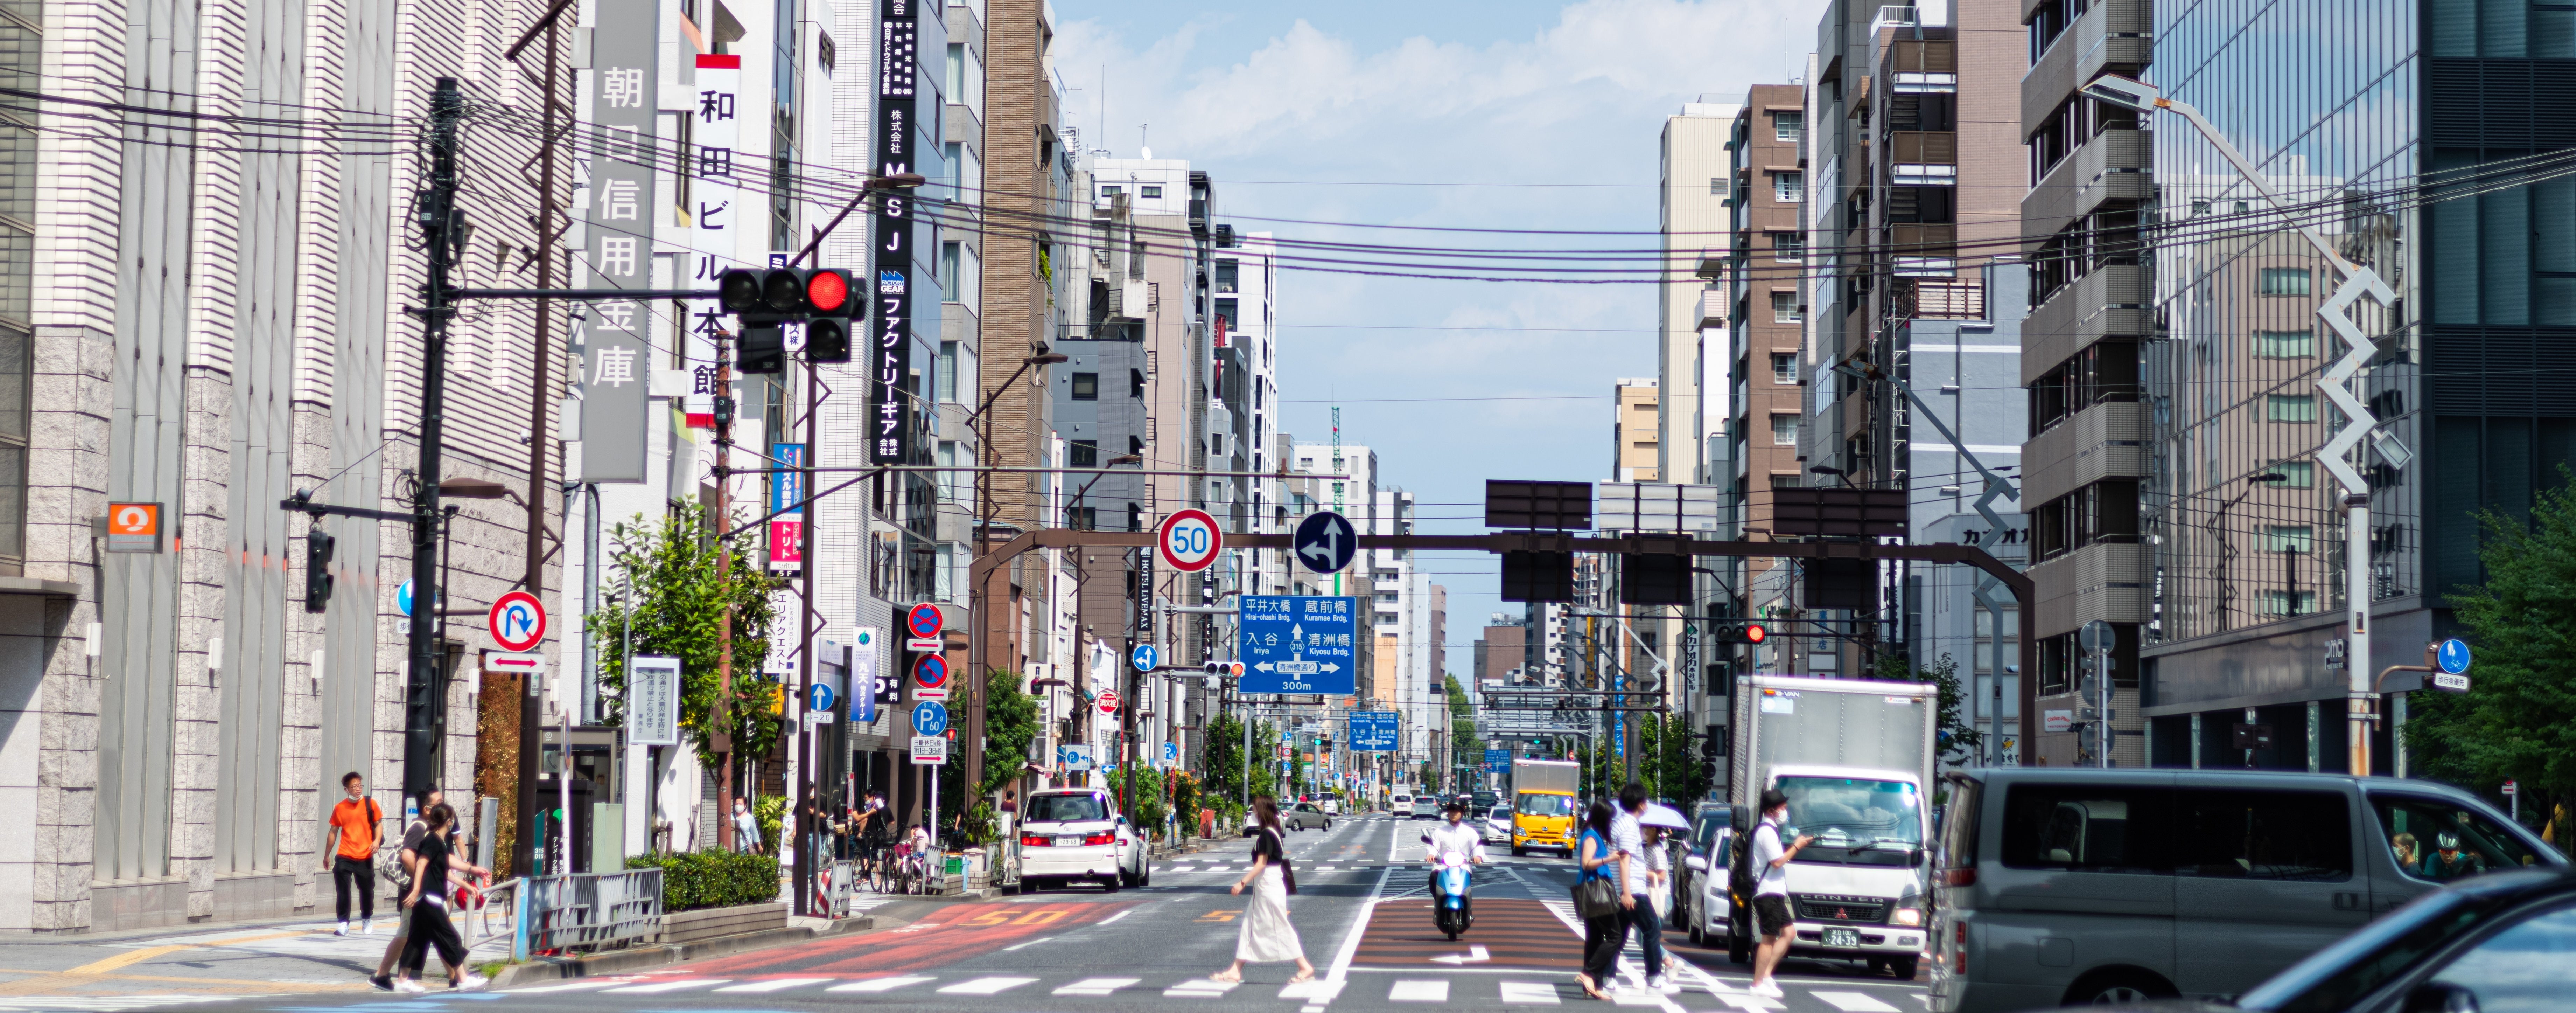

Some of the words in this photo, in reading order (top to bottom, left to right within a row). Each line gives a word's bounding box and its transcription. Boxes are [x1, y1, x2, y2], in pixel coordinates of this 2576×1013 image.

[890, 110, 902, 153] 株式会社
[881, 299, 899, 435] ファクトリーギア
[1174, 527, 1206, 554] 50
[1246, 599, 1290, 612] 平井大橋
[1305, 600, 1347, 613] 蔵前橋
[777, 595, 786, 669] エリアクエスト
[1246, 632, 1278, 646] 入谷
[1308, 633, 1350, 647] 清洲橋
[1279, 663, 1315, 672] 清洲橋通り
[1283, 682, 1311, 690] 300m
[2438, 676, 2464, 686] 歩行者優先
[889, 679, 898, 701] 有料
[646, 669, 655, 728] 車両通行禁止となります
[658, 670, 666, 739] この通りは大震災発生時には
[1100, 699, 1116, 707] 消火栓
[920, 709, 933, 731] P
[929, 721, 939, 731] 60
[958, 911, 1069, 926] 50
[1831, 935, 1857, 946] 24-39
